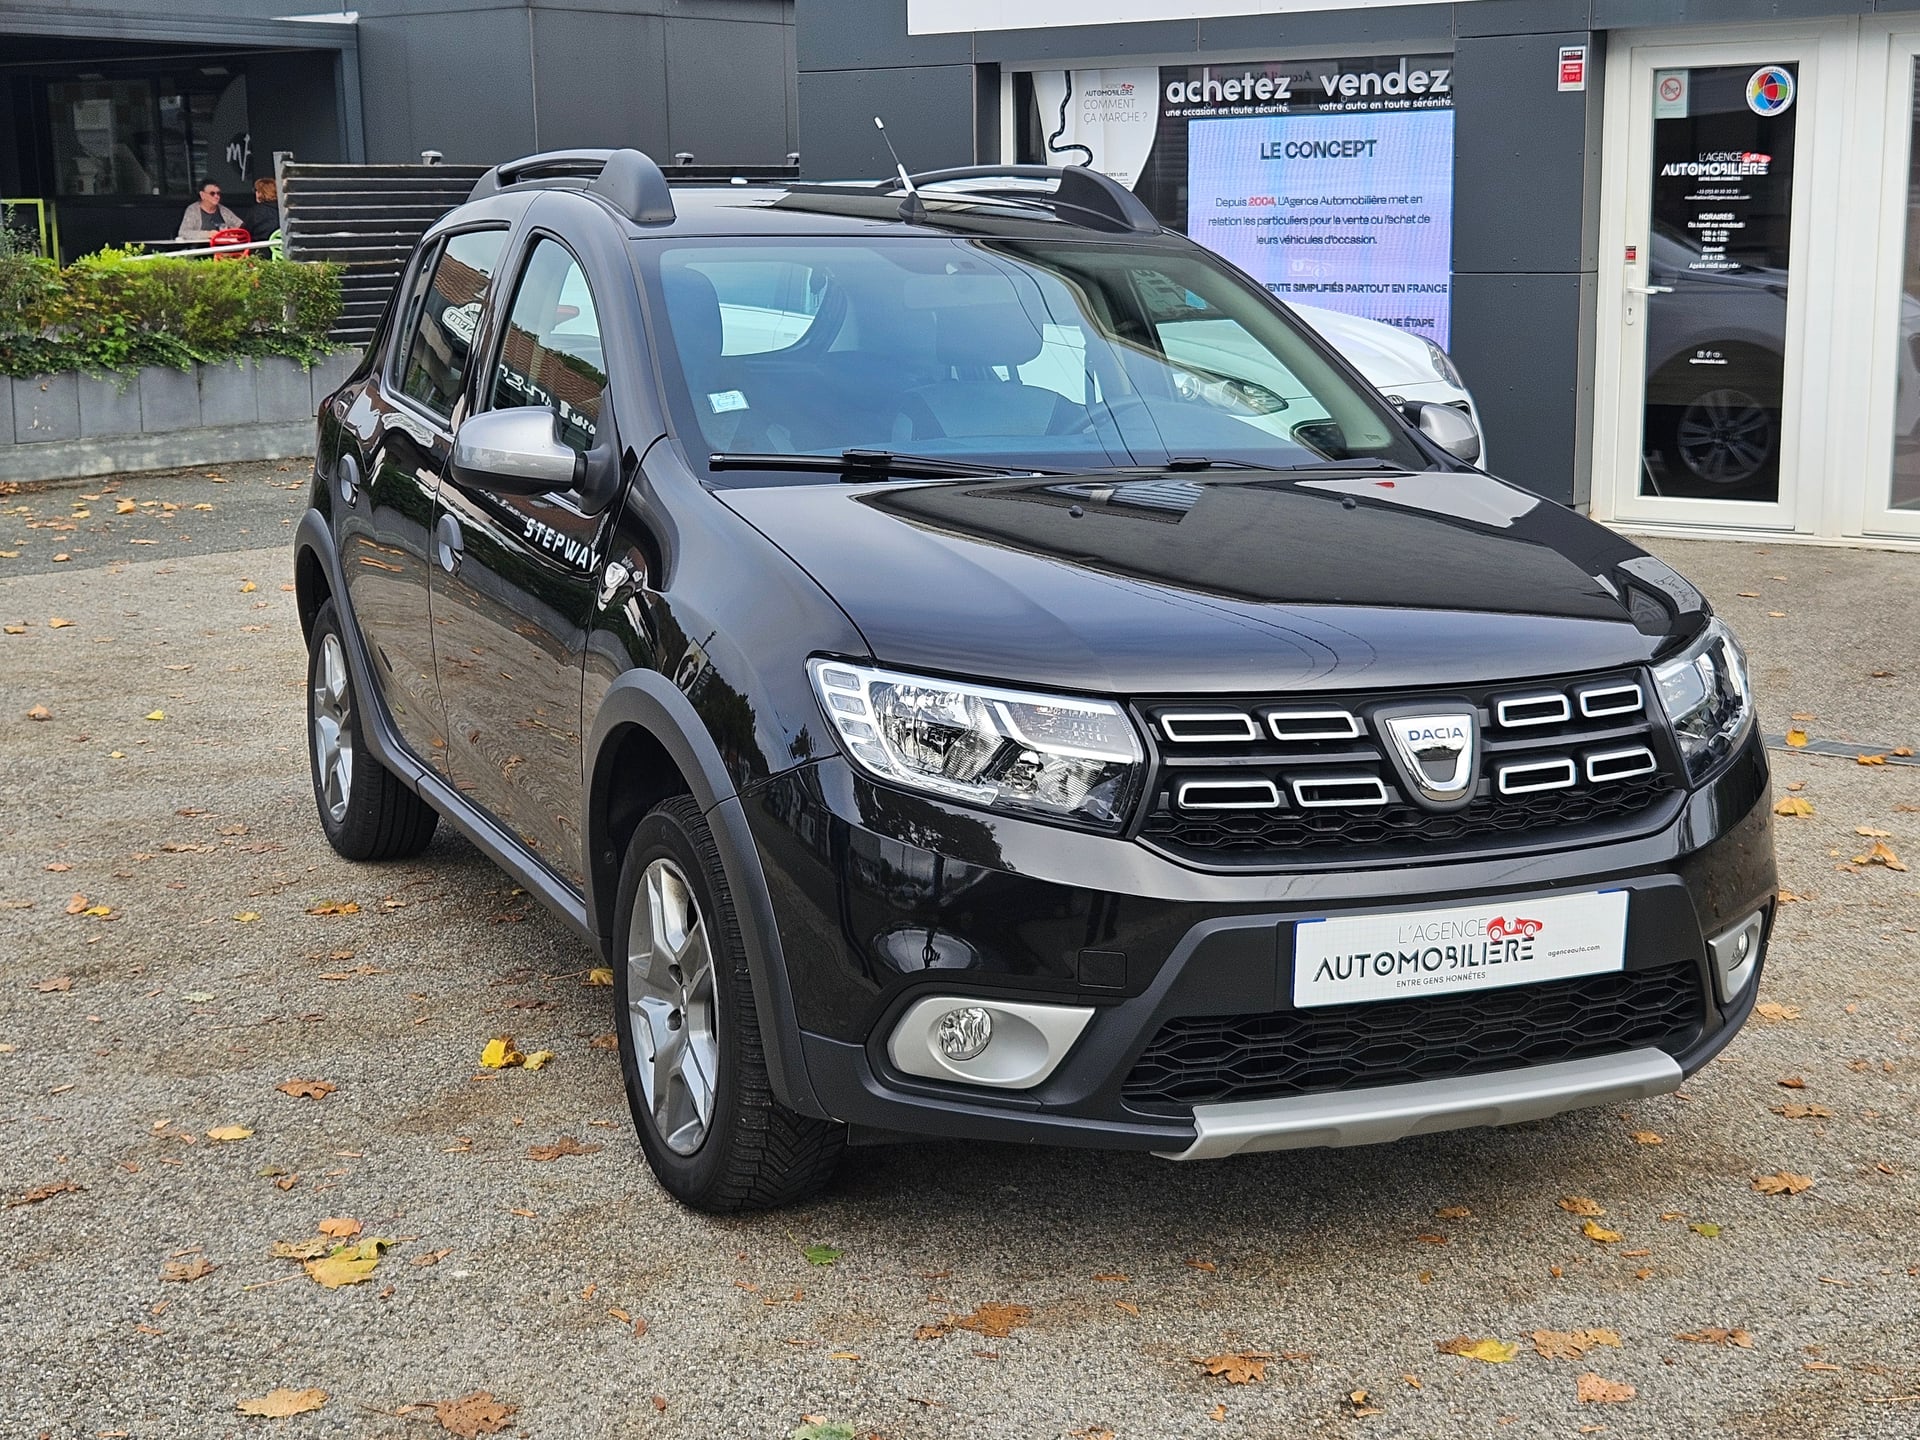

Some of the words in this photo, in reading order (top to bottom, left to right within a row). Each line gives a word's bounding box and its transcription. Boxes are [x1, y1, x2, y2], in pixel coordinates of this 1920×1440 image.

[1320, 57, 1450, 97] vendez
[1166, 67, 1291, 103] achetez
[1083, 98, 1136, 110] COMMENT
[1165, 109, 1181, 117] une
[1182, 107, 1216, 116] occasion
[1218, 107, 1229, 115] en
[1231, 105, 1252, 114] toute
[1255, 103, 1290, 114] sécurité.
[1319, 102, 1343, 111] votre
[1345, 101, 1367, 110] auto
[1370, 101, 1381, 109] en
[1384, 100, 1410, 109] toute
[1412, 96, 1454, 108] sérénité.
[1083, 112, 1096, 125] ÇA
[1099, 111, 1140, 122] MARCHE
[1142, 111, 1148, 121] ?
[1261, 142, 1281, 160] LE
[1285, 139, 1377, 159] CONCEPT
[1698, 152, 1742, 162] L'AGENCE
[1215, 197, 1247, 208] Depuis
[1278, 196, 1318, 208] L'Agence
[1320, 195, 1387, 206] Automobilière
[1388, 194, 1409, 204] met
[1410, 196, 1422, 204] en
[1208, 216, 1242, 226] relation
[1243, 216, 1256, 226] les
[1257, 215, 1308, 227] particuliers
[1309, 216, 1331, 227] pour
[1341, 215, 1369, 225] vente
[1370, 216, 1383, 225] ou
[1418, 214, 1430, 223] de
[1256, 235, 1278, 244] leurs
[1279, 234, 1323, 244] véhicules
[1324, 234, 1377, 244] d'occasion.
[1293, 281, 1344, 293] SIMPLIFIÉS
[1345, 283, 1390, 293] PARTOUT
[1392, 283, 1405, 293] EN
[1407, 283, 1448, 293] FRANCE
[1404, 315, 1435, 328] ÉTAPE
[523, 518, 601, 572] STEPWAY
[1408, 727, 1464, 741] DACIA
[1398, 917, 1487, 944] L'AGENCE
[1547, 944, 1600, 957] agenceauto.com
[1396, 979, 1421, 988] ENTRE
[1423, 976, 1444, 985] GENS
[1446, 971, 1486, 983] HONNÊTES
